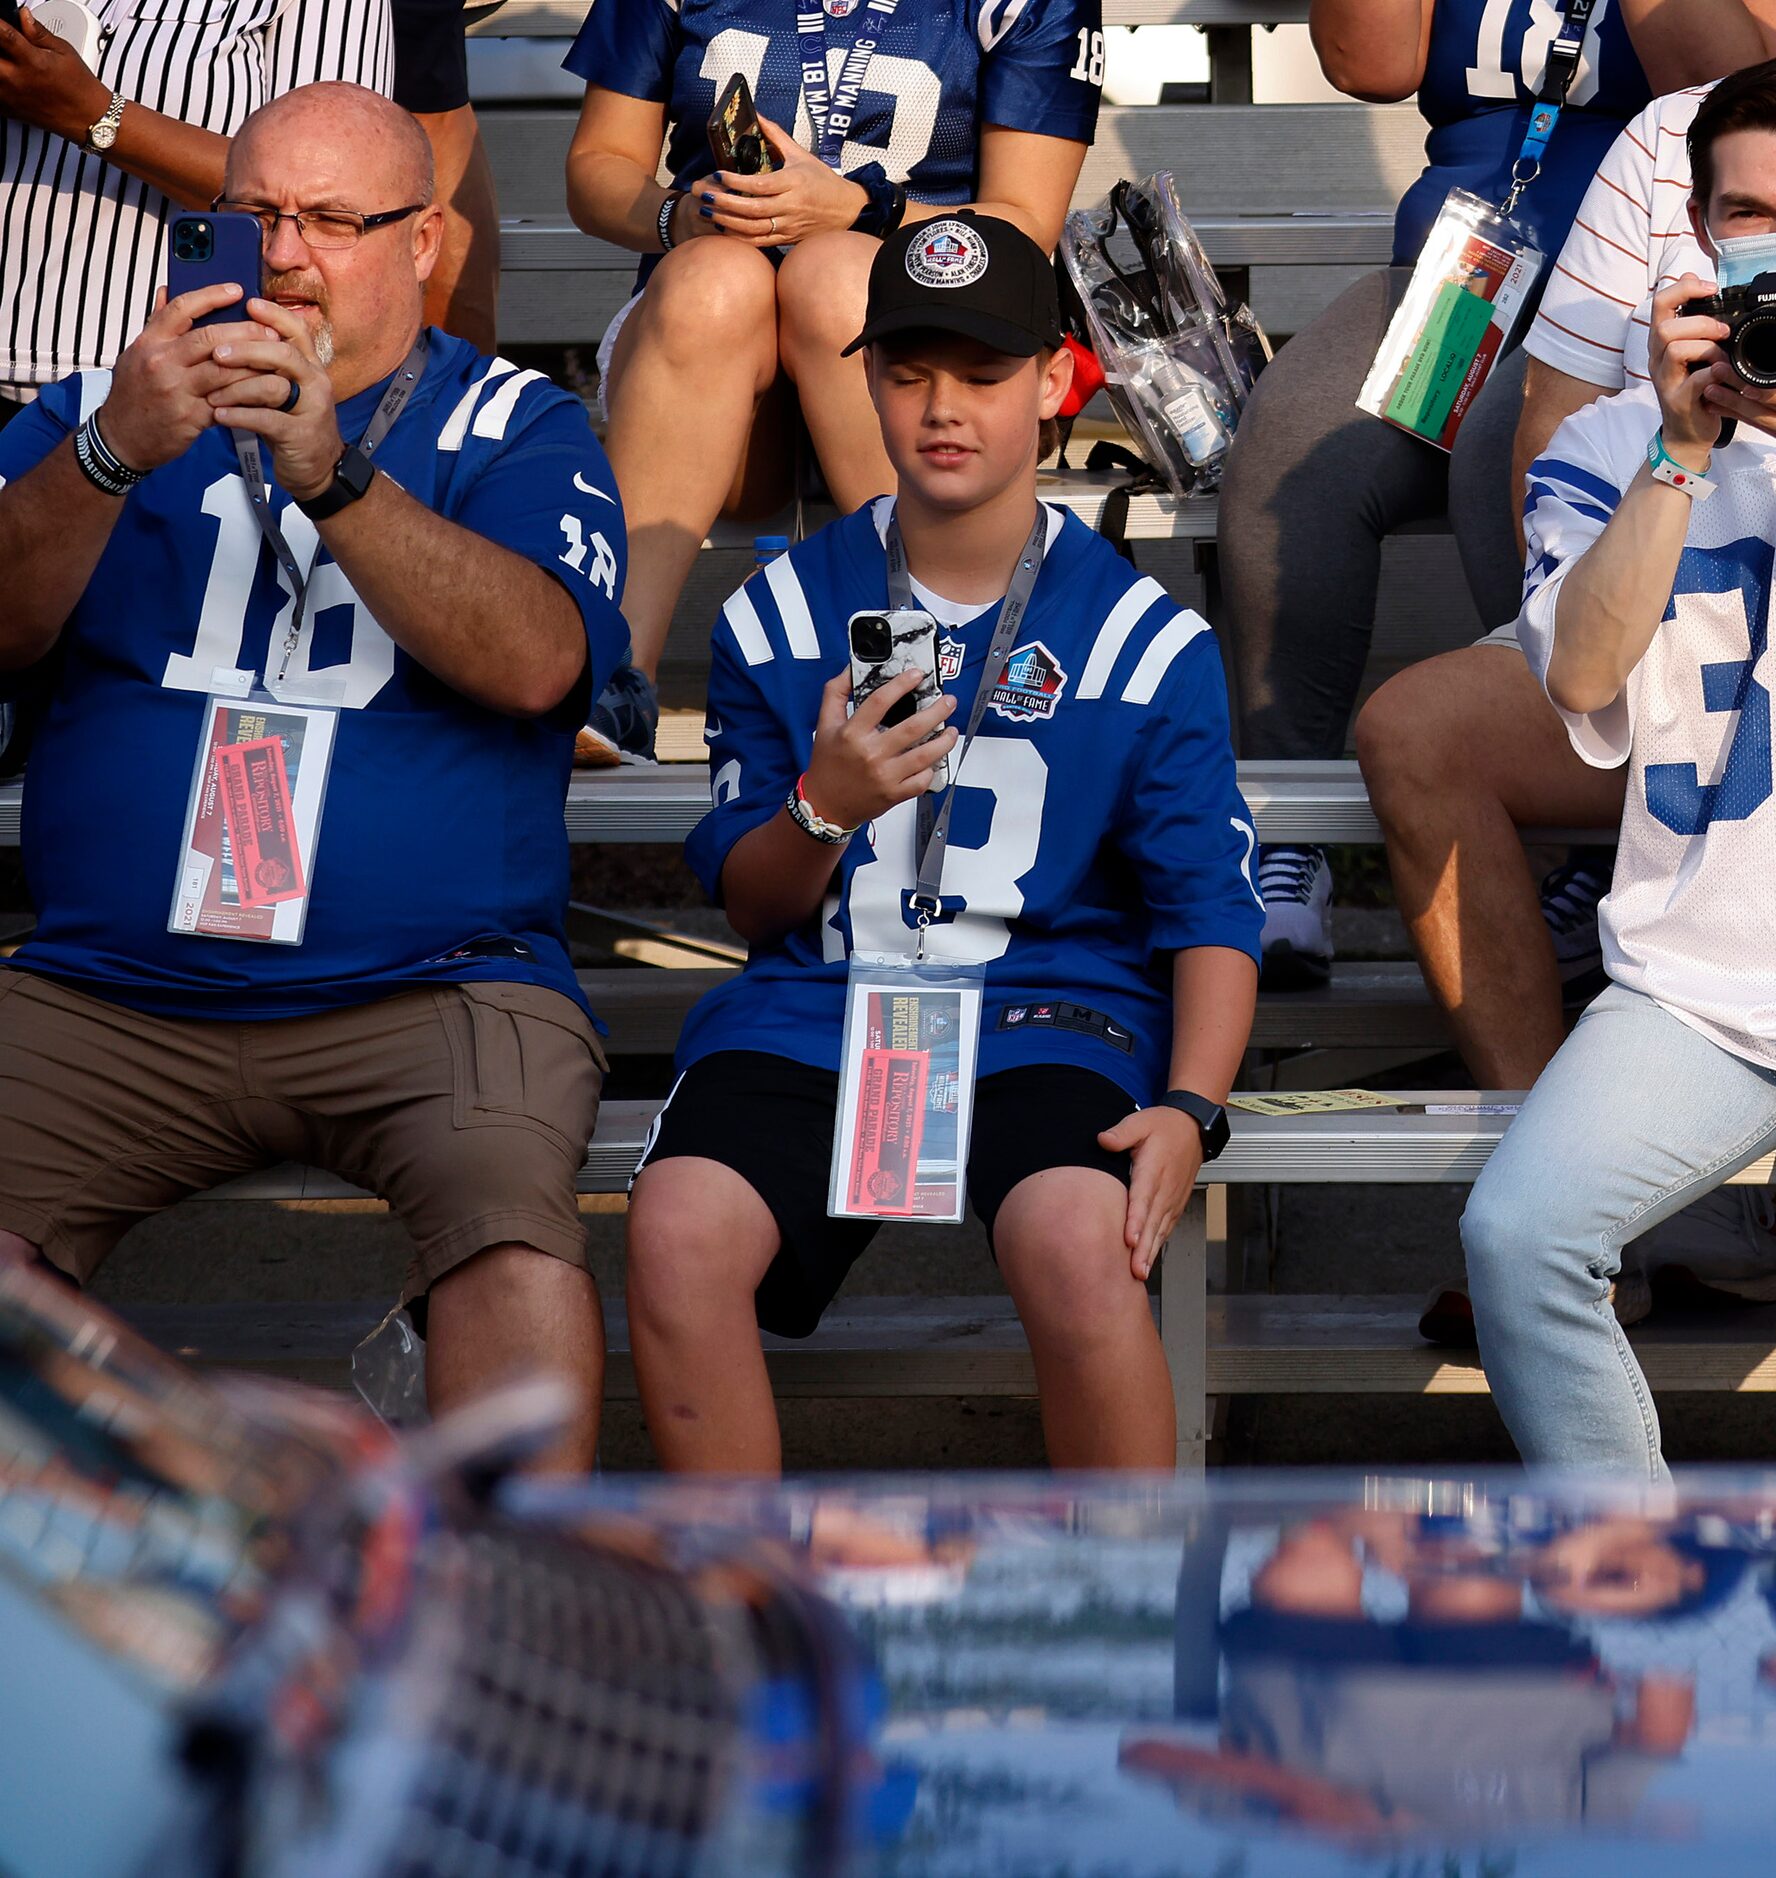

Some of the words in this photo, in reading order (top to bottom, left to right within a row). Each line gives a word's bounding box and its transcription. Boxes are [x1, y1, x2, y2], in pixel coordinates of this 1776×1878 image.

[800, 59, 826, 84] 18
[834, 35, 876, 110] MANNING
[1070, 27, 1105, 87] 18
[826, 111, 851, 138] 18
[1509, 263, 1524, 284] 2021
[1465, 357, 1482, 382] AUGUST
[1418, 388, 1441, 424] Repository
[84, 457, 121, 490] SATURDAY
[162, 473, 395, 709] 18
[940, 656, 955, 674] FL
[993, 690, 1017, 705] HALL
[1023, 696, 1049, 712] FAME
[1011, 685, 1053, 699] FOOTBALL
[206, 782, 216, 809] AUGUST
[229, 763, 245, 801] GRAND
[236, 803, 253, 847] PARADE
[821, 735, 1048, 963] 8
[183, 902, 193, 926] 2021
[891, 997, 908, 1050] REVEALED
[908, 997, 919, 1050] ENSHRINEMENT
[1072, 1007, 1092, 1021] M
[868, 1068, 882, 1105] GRAND
[864, 1109, 878, 1152] PARADE
